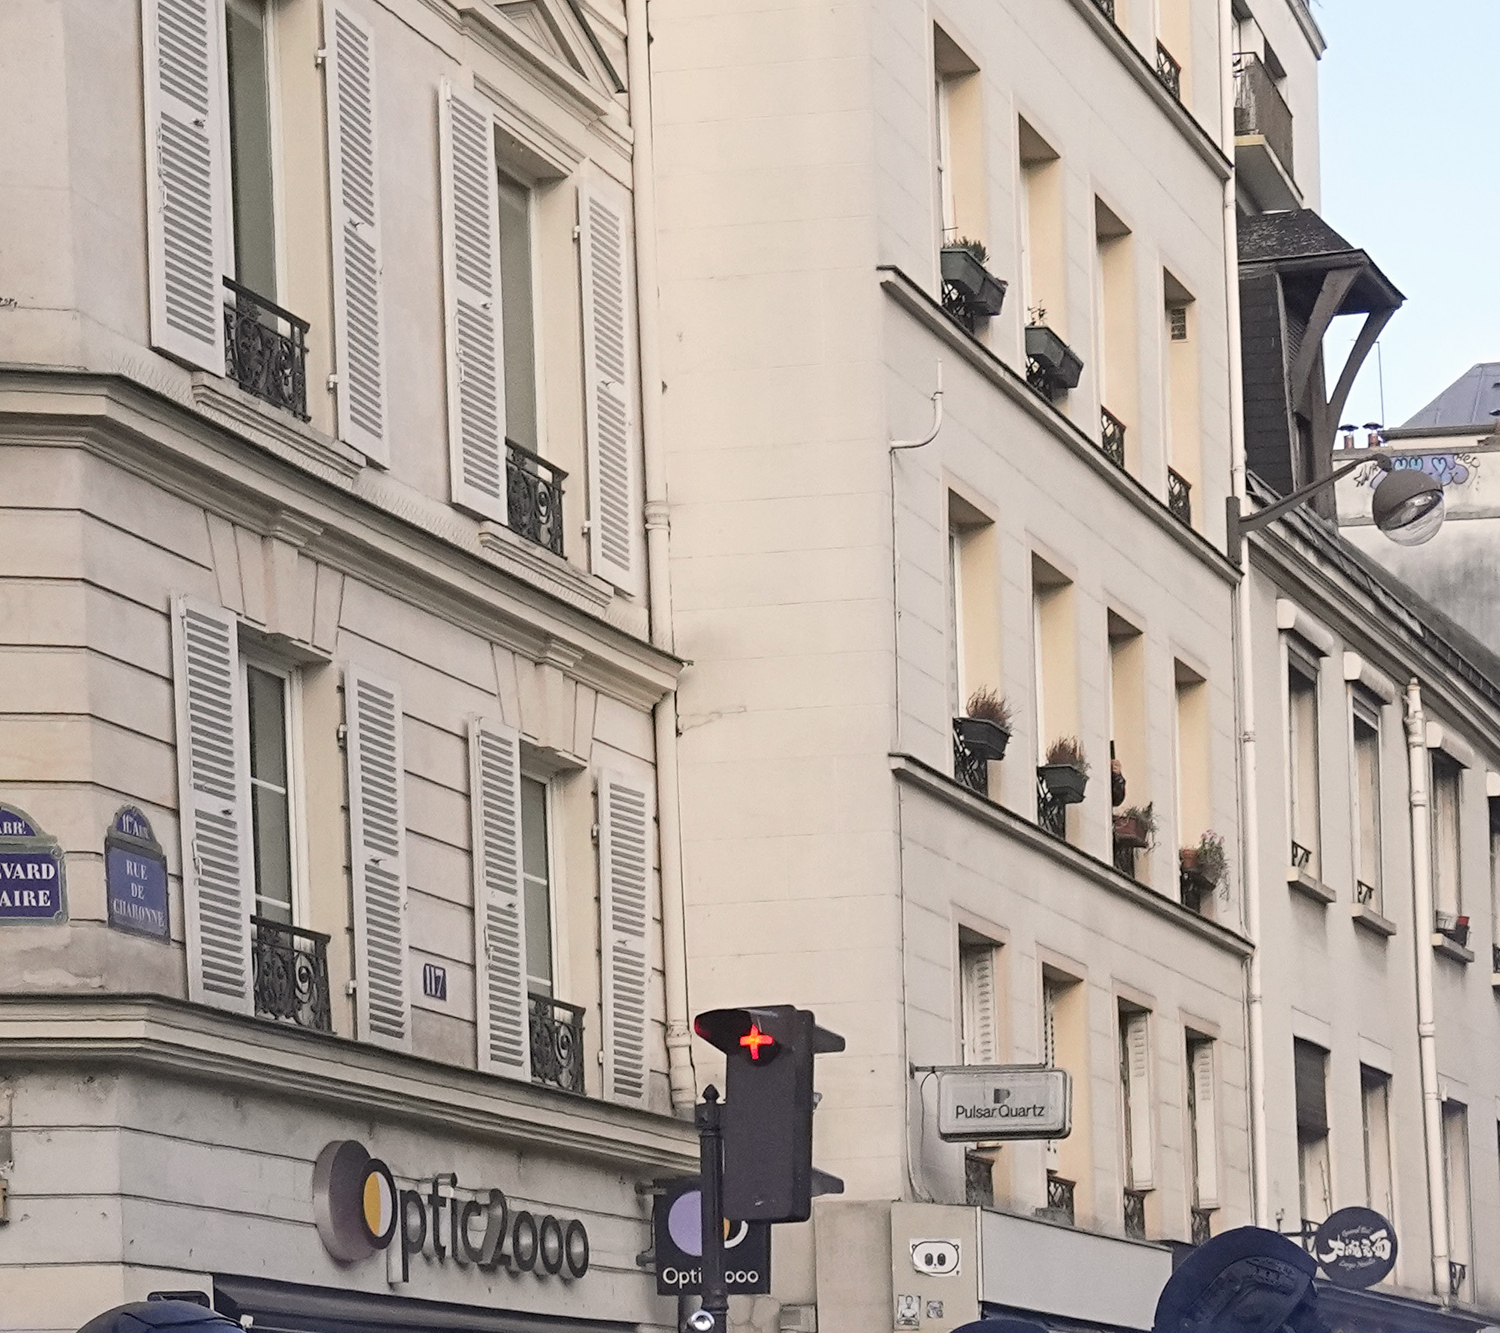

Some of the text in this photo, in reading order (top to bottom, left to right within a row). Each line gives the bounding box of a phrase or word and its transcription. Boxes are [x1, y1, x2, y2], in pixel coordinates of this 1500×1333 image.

[125, 859, 148, 881] RUE
[130, 882, 145, 900] DE
[113, 898, 166, 927] CHARONNE
[424, 965, 446, 999] 117
[955, 1103, 1046, 1119] Pulsar Quartz
